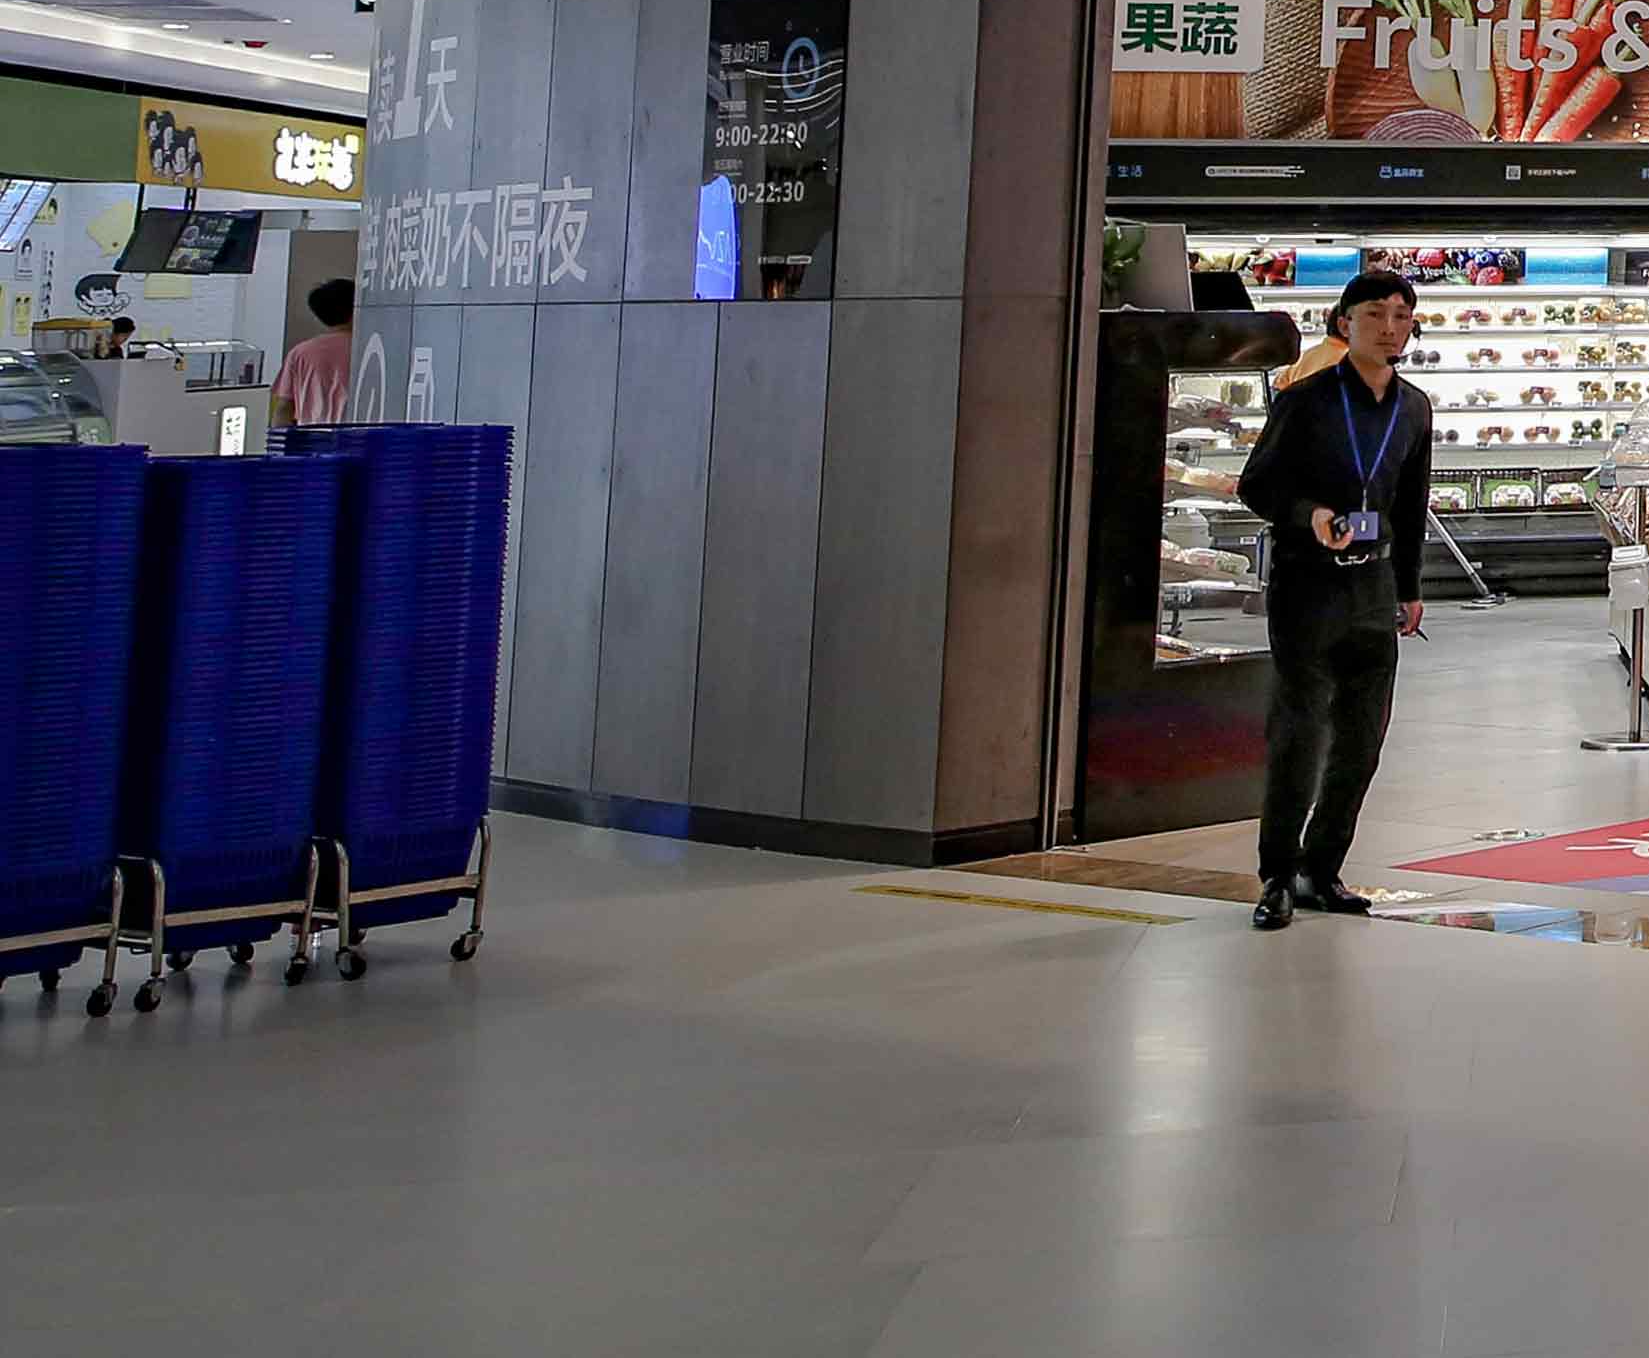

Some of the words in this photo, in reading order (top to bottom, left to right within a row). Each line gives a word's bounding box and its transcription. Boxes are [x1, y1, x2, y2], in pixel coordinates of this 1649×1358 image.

[1120, 1, 1240, 56] 果蔬
[720, 41, 769, 65] 营业时间
